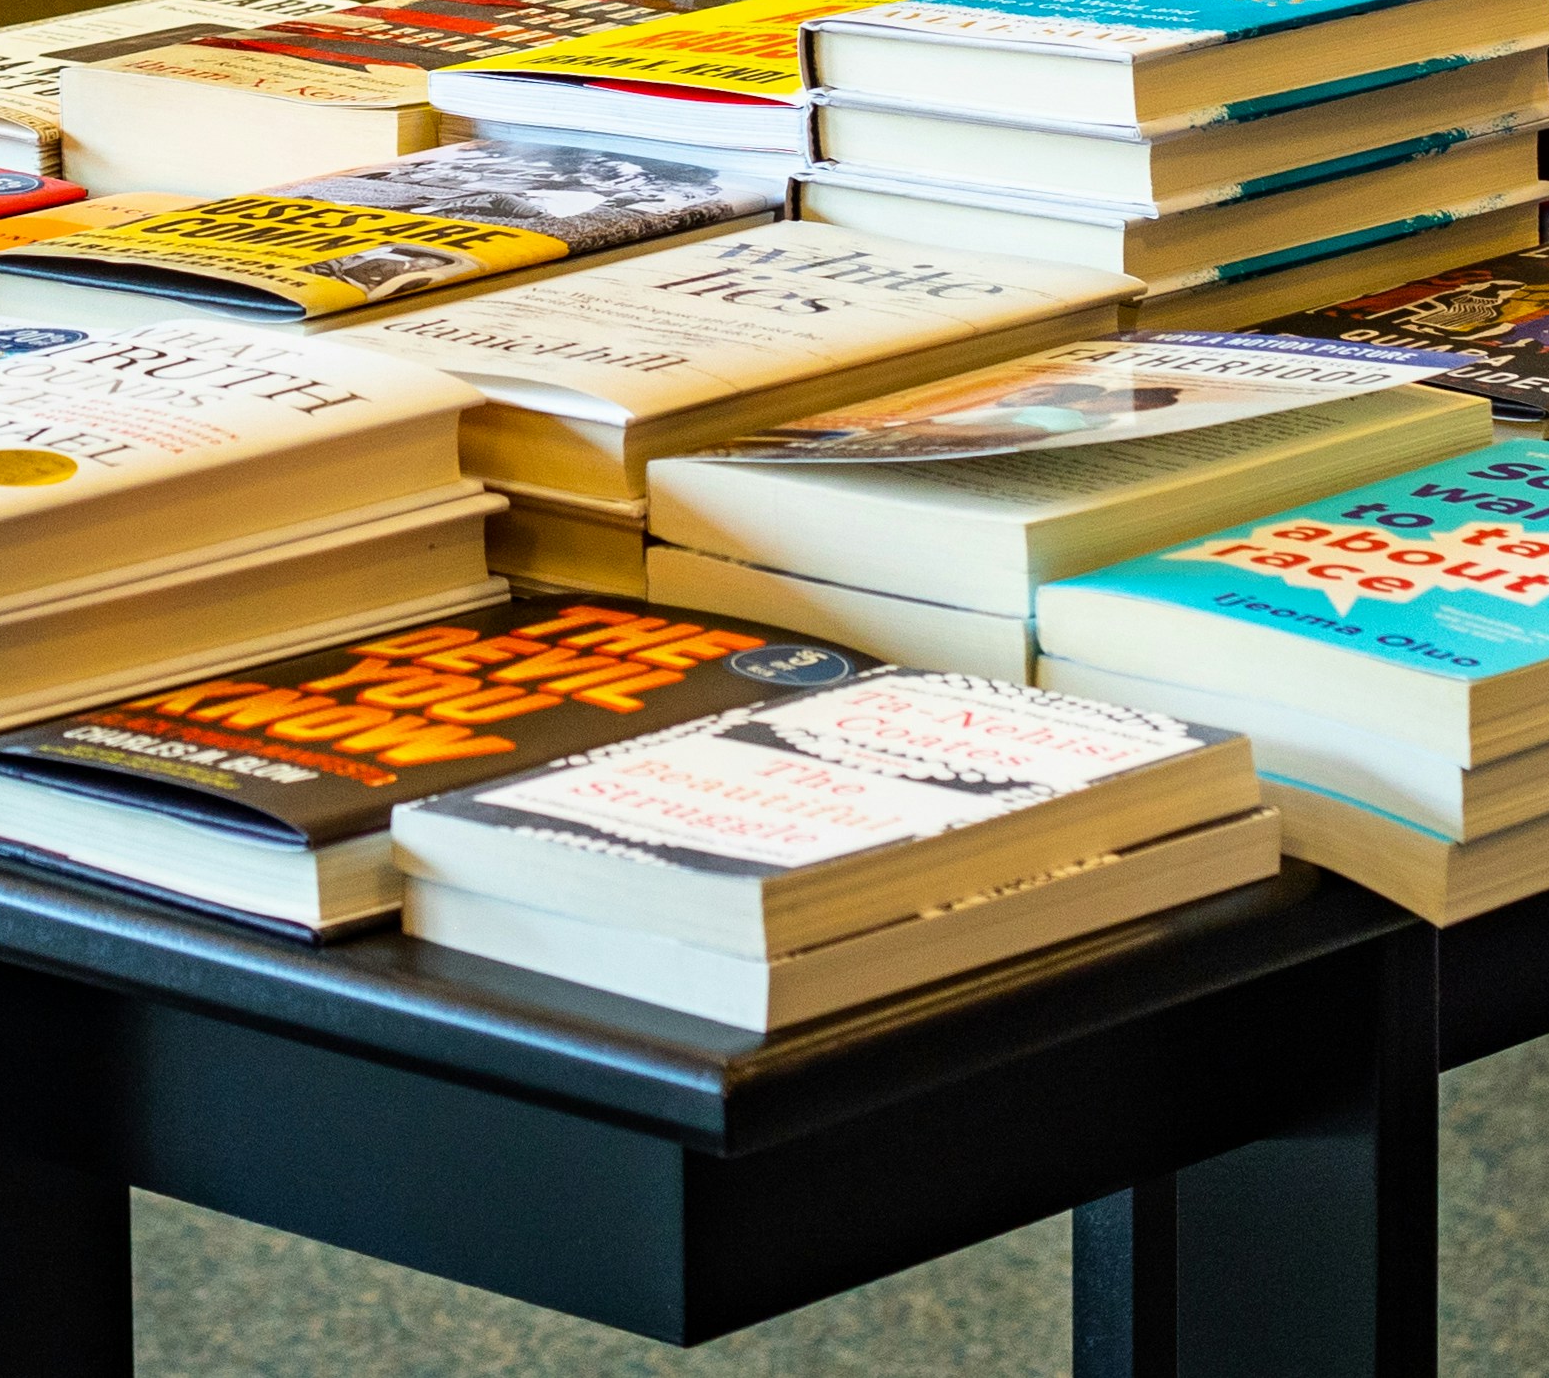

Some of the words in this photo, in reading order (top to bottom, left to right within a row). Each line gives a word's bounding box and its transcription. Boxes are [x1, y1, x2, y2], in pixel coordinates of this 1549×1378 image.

[671, 59, 797, 85] KENDI
[370, 212, 520, 253] ARE
[652, 265, 857, 316] lies
[713, 241, 1006, 303] white
[1044, 347, 1393, 387] FATHERHOOD
[1149, 331, 1201, 344] NOW
[1228, 336, 1318, 355] MOTION
[1323, 343, 1420, 364] PICTURE
[44, 340, 372, 417] TRUTH
[1338, 502, 1435, 530] to
[1210, 542, 1417, 598] race
[522, 604, 769, 671] THE
[1211, 591, 1365, 638] Ijeoma
[1375, 633, 1483, 670] Oluo
[300, 657, 562, 728] YOU
[348, 626, 685, 714] DEVIL
[126, 678, 520, 768] KNOW
[835, 714, 1039, 771] Coates
[850, 688, 1146, 765] Ta-Nehisi
[63, 725, 195, 760] CHARLES
[212, 755, 320, 785] BLOW
[756, 756, 868, 799] The
[567, 778, 820, 848] Struggle
[613, 758, 905, 835] Beautiful
